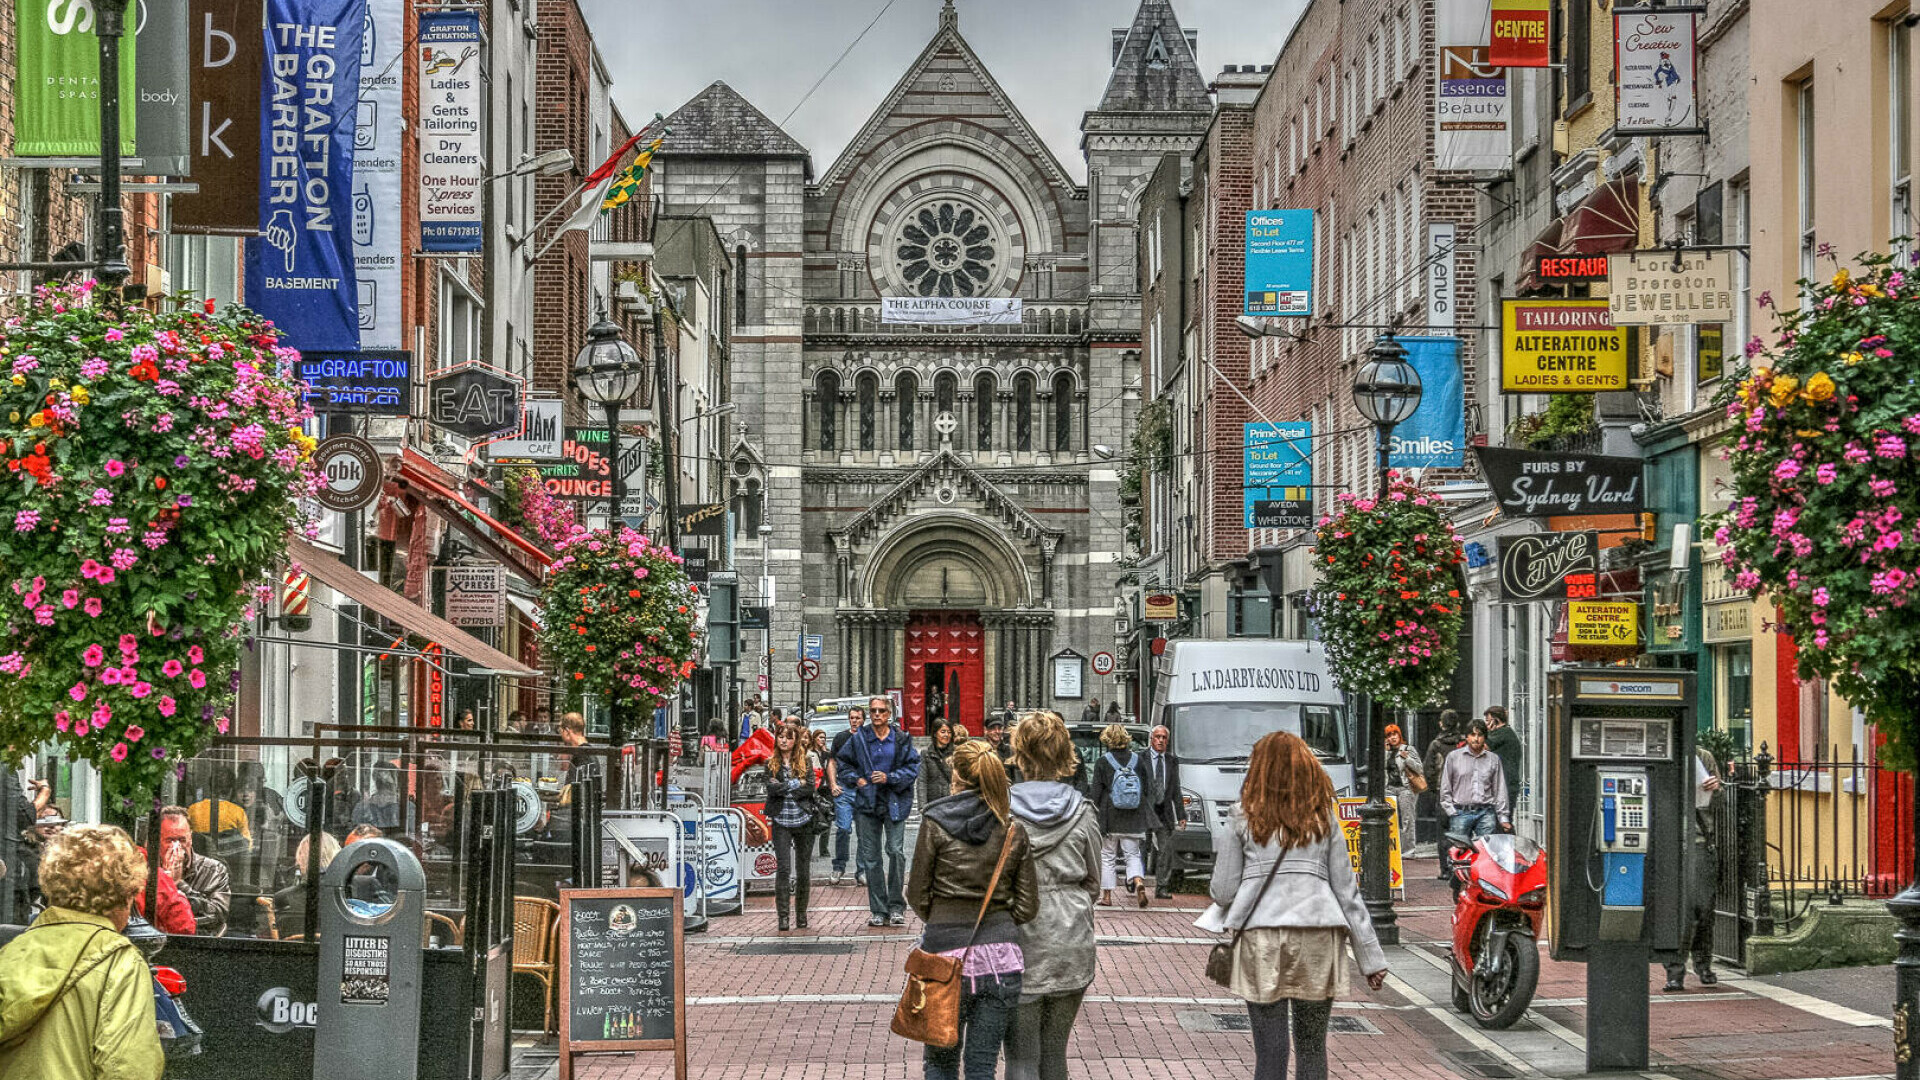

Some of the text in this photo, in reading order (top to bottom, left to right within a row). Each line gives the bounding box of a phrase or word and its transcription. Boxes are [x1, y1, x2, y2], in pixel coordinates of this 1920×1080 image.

[430, 24, 469, 32] GRAFTON
[1495, 20, 1546, 38] CENTRE
[1637, 14, 1676, 35] Sew
[276, 23, 337, 49] THE
[422, 32, 477, 40] ALTERATIONS
[1625, 34, 1682, 52] Creative
[47, 77, 99, 86] DENTA
[360, 74, 397, 85] enders
[430, 79, 470, 90] Ladies
[58, 90, 98, 99] SPAS
[1440, 81, 1505, 96] Essence
[141, 88, 179, 105] body
[446, 92, 455, 103] &
[432, 106, 469, 117] Gents
[1438, 101, 1504, 117] Beauty
[269, 53, 300, 205] BARBER
[422, 118, 478, 131] Tailoring
[304, 54, 336, 231] GRAFTON
[439, 140, 462, 154] Dry
[423, 153, 478, 165] Cleaners
[422, 175, 479, 187] One Hour
[428, 187, 474, 202] Xpress
[427, 203, 475, 215] Services
[1251, 216, 1284, 226] Offices
[436, 226, 446, 236] 01
[447, 226, 480, 236] 6717813
[1251, 228, 1280, 237] To Let
[1434, 233, 1452, 315] L'Avenue
[1540, 257, 1608, 278] RESTAUR
[265, 277, 340, 290] BASEMENT
[1626, 276, 1717, 291] Brereton
[889, 300, 991, 310] THE ALPHA COURSE
[1611, 291, 1732, 313] JEWELLER
[1522, 310, 1610, 328] TAILORING
[1515, 335, 1620, 351] ALTERATIONS
[321, 359, 408, 379] GRAFTON
[1536, 354, 1596, 371] CENTRE
[1515, 375, 1619, 386] LADIES & GENTS
[435, 383, 512, 427] EAT
[576, 430, 611, 443] WINE
[1249, 428, 1306, 438] Prime Retail
[1249, 440, 1269, 450] Unit
[1389, 435, 1454, 455] Smiles
[318, 442, 348, 462] gourmet
[350, 443, 372, 463] burger
[1250, 451, 1278, 460] To Let
[327, 460, 361, 483] gbk
[541, 464, 580, 477] SPIRITS
[1522, 461, 1586, 474] FURS BY
[544, 478, 613, 497] OUNGE
[1504, 475, 1639, 513] Sydney Vard
[328, 494, 360, 503] kitchen
[1268, 501, 1299, 509] AVEDA
[1257, 516, 1311, 527] WHETSTONE
[1503, 534, 1594, 597] Cave
[1564, 574, 1596, 584] WINE
[1567, 585, 1596, 598] BAR
[1576, 605, 1629, 615] ALTERATION
[460, 617, 494, 625] 6717813
[1586, 614, 1620, 622] CENTRE
[1098, 657, 1109, 667] 50
[1297, 671, 1320, 692] LTD
[1620, 683, 1652, 693] eircom
[345, 937, 389, 950] LITTER IS
[345, 949, 388, 959] DISGUSTING
[345, 960, 387, 968] SO ARE THOSE
[344, 967, 387, 976] RESPONSIBLE
[273, 996, 318, 1025] Boc
